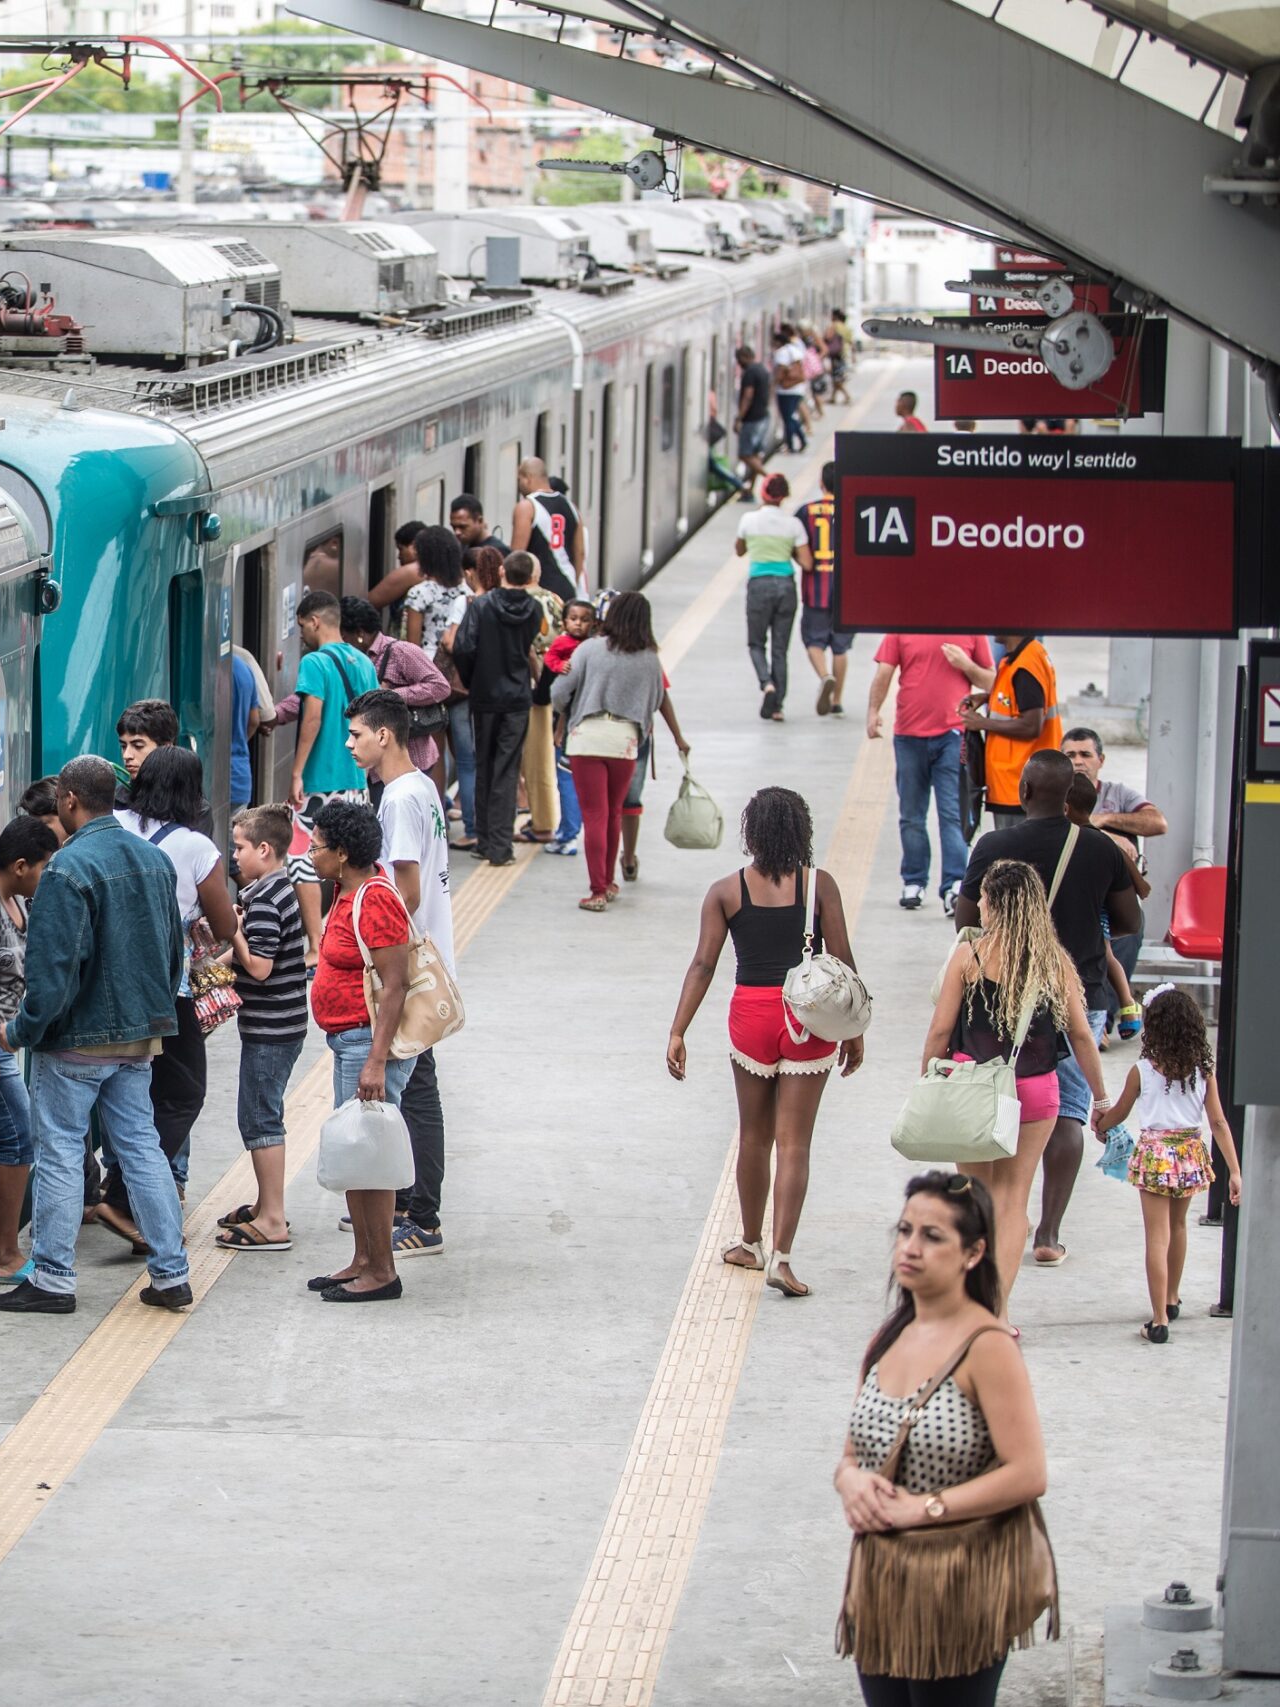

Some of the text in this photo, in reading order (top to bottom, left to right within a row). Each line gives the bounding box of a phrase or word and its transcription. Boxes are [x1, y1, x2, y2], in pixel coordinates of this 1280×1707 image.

[977, 297, 996, 311] 1A
[945, 354, 972, 374] 1A
[937, 445, 1137, 471] Sentido way sentido
[551, 513, 566, 551] 8
[859, 505, 1084, 548] 1A Deodoro
